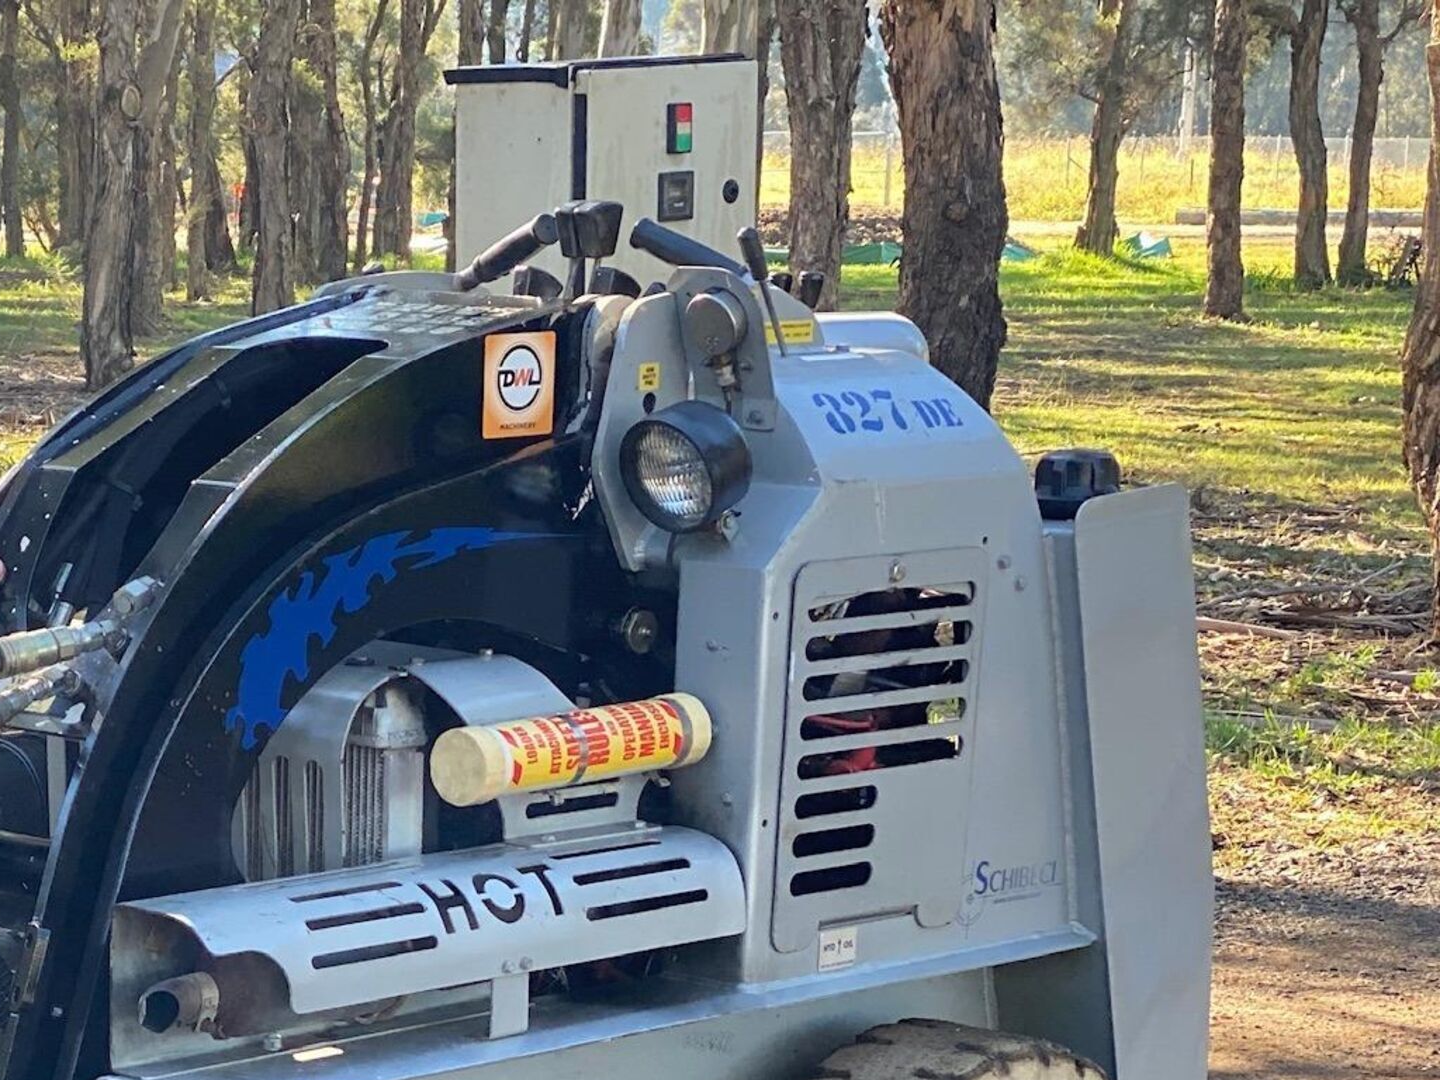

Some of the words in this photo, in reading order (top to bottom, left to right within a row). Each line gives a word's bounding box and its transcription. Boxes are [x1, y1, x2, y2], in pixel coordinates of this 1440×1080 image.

[497, 367, 541, 388] DWL
[812, 389, 908, 434] 327
[911, 398, 964, 428] DE
[512, 725, 538, 764] LOADER
[417, 864, 565, 934] HOT
